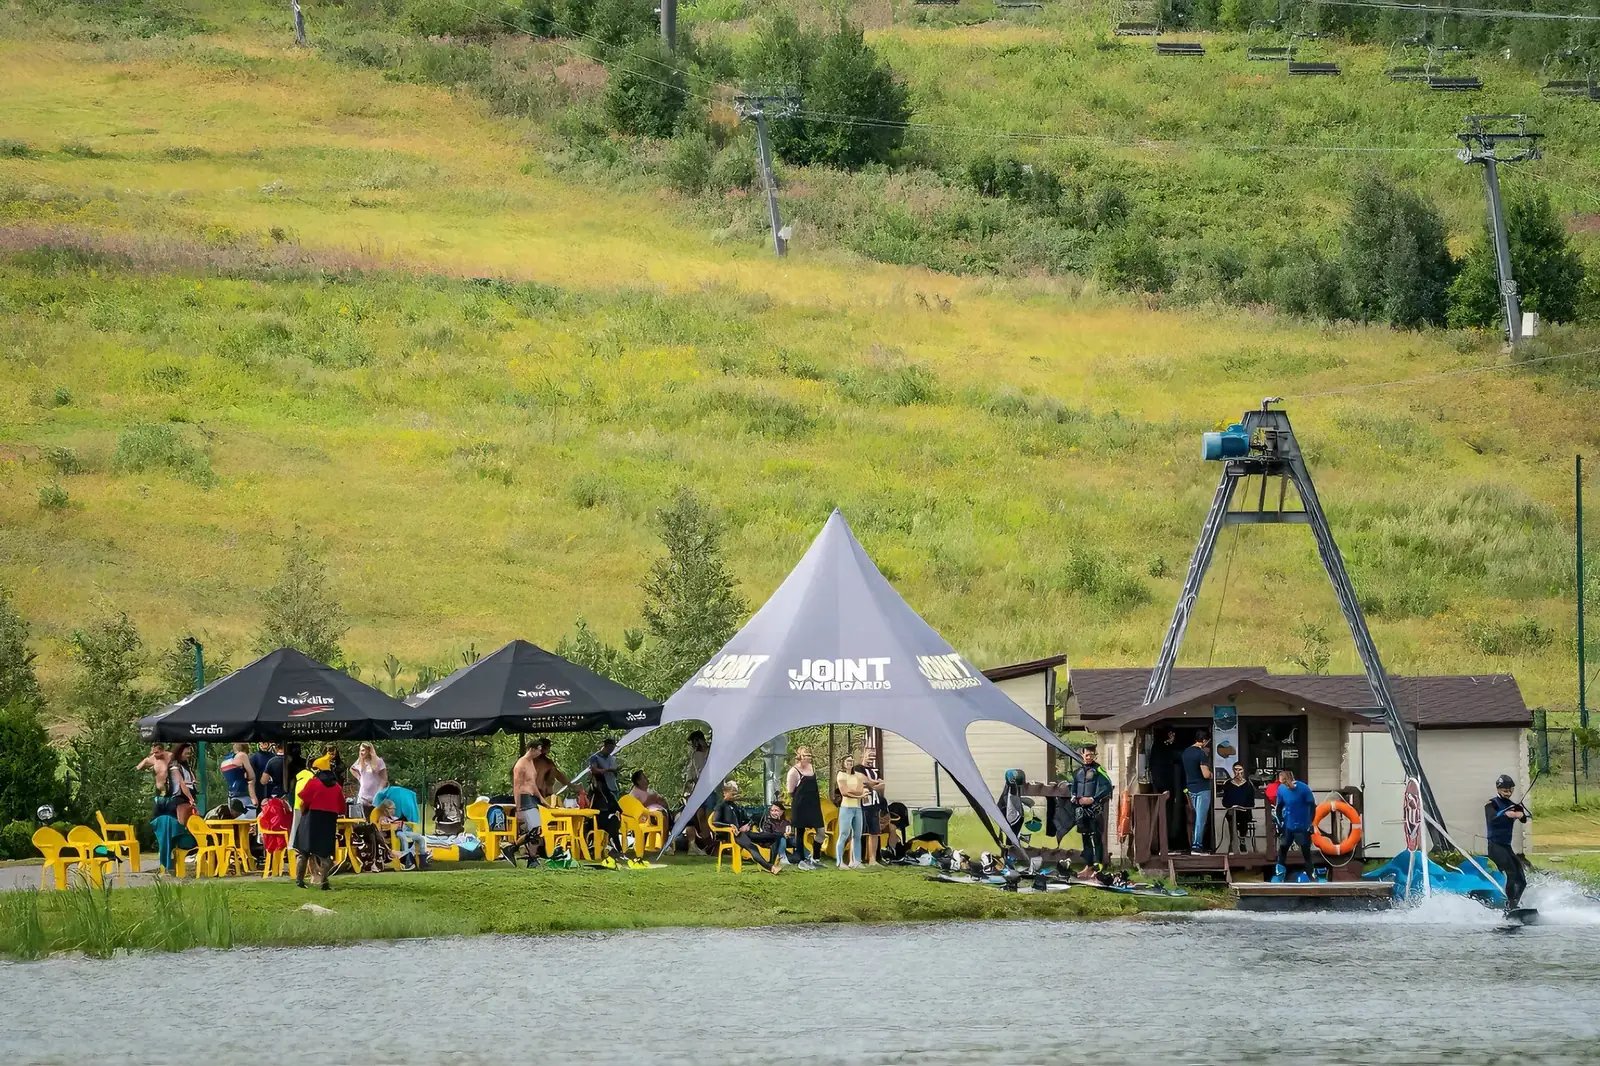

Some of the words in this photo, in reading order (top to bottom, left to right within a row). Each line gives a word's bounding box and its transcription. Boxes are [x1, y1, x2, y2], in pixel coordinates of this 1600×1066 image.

[703, 654, 770, 679] JOINT
[788, 657, 891, 682] JOINT
[916, 652, 972, 680] JOINT
[433, 719, 467, 730] Jardin
